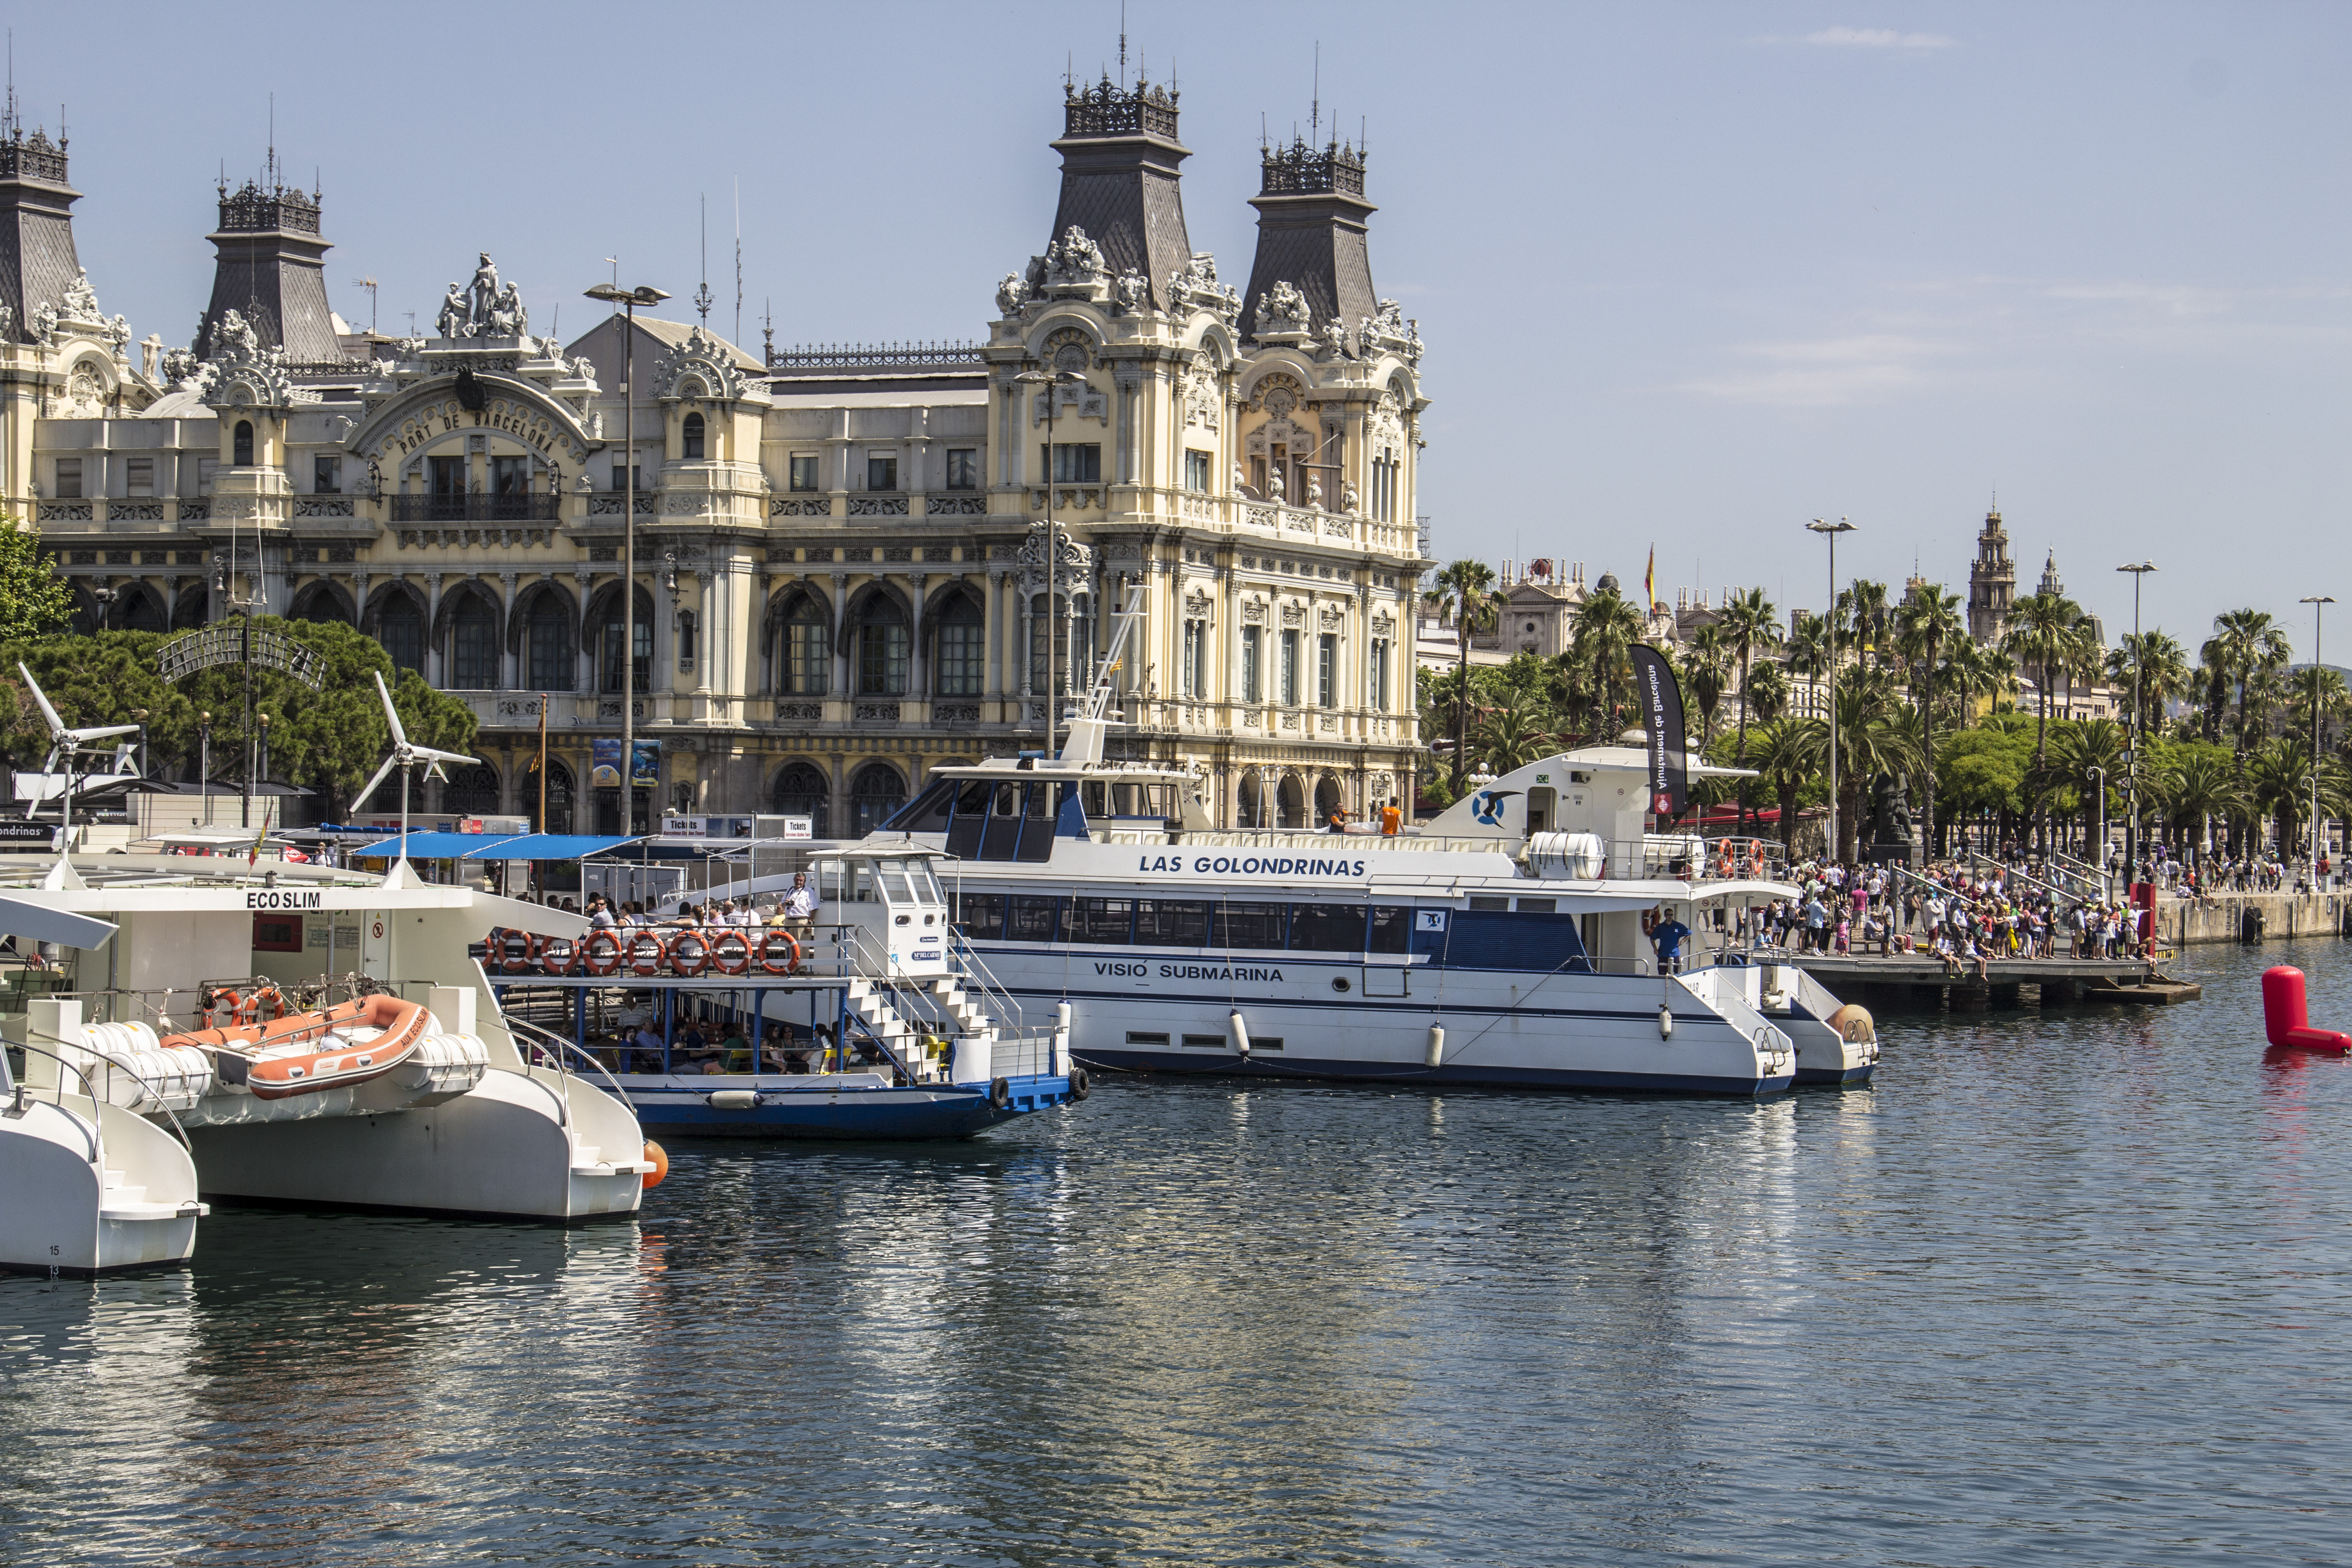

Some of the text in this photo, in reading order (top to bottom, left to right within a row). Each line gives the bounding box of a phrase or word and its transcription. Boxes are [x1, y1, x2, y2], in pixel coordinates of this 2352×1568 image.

[400, 412, 554, 455] PORT DE BARCELONA
[790, 822, 806, 830] Tickets
[1139, 856, 1365, 877] LAS GOLONDRINAS
[2328, 897, 2331, 913] 8
[1094, 959, 1284, 981] VISIÓ SUBMARINA
[401, 1034, 412, 1048] AUX
[49, 1245, 59, 1255] 15
[49, 1265, 59, 1275] 13
